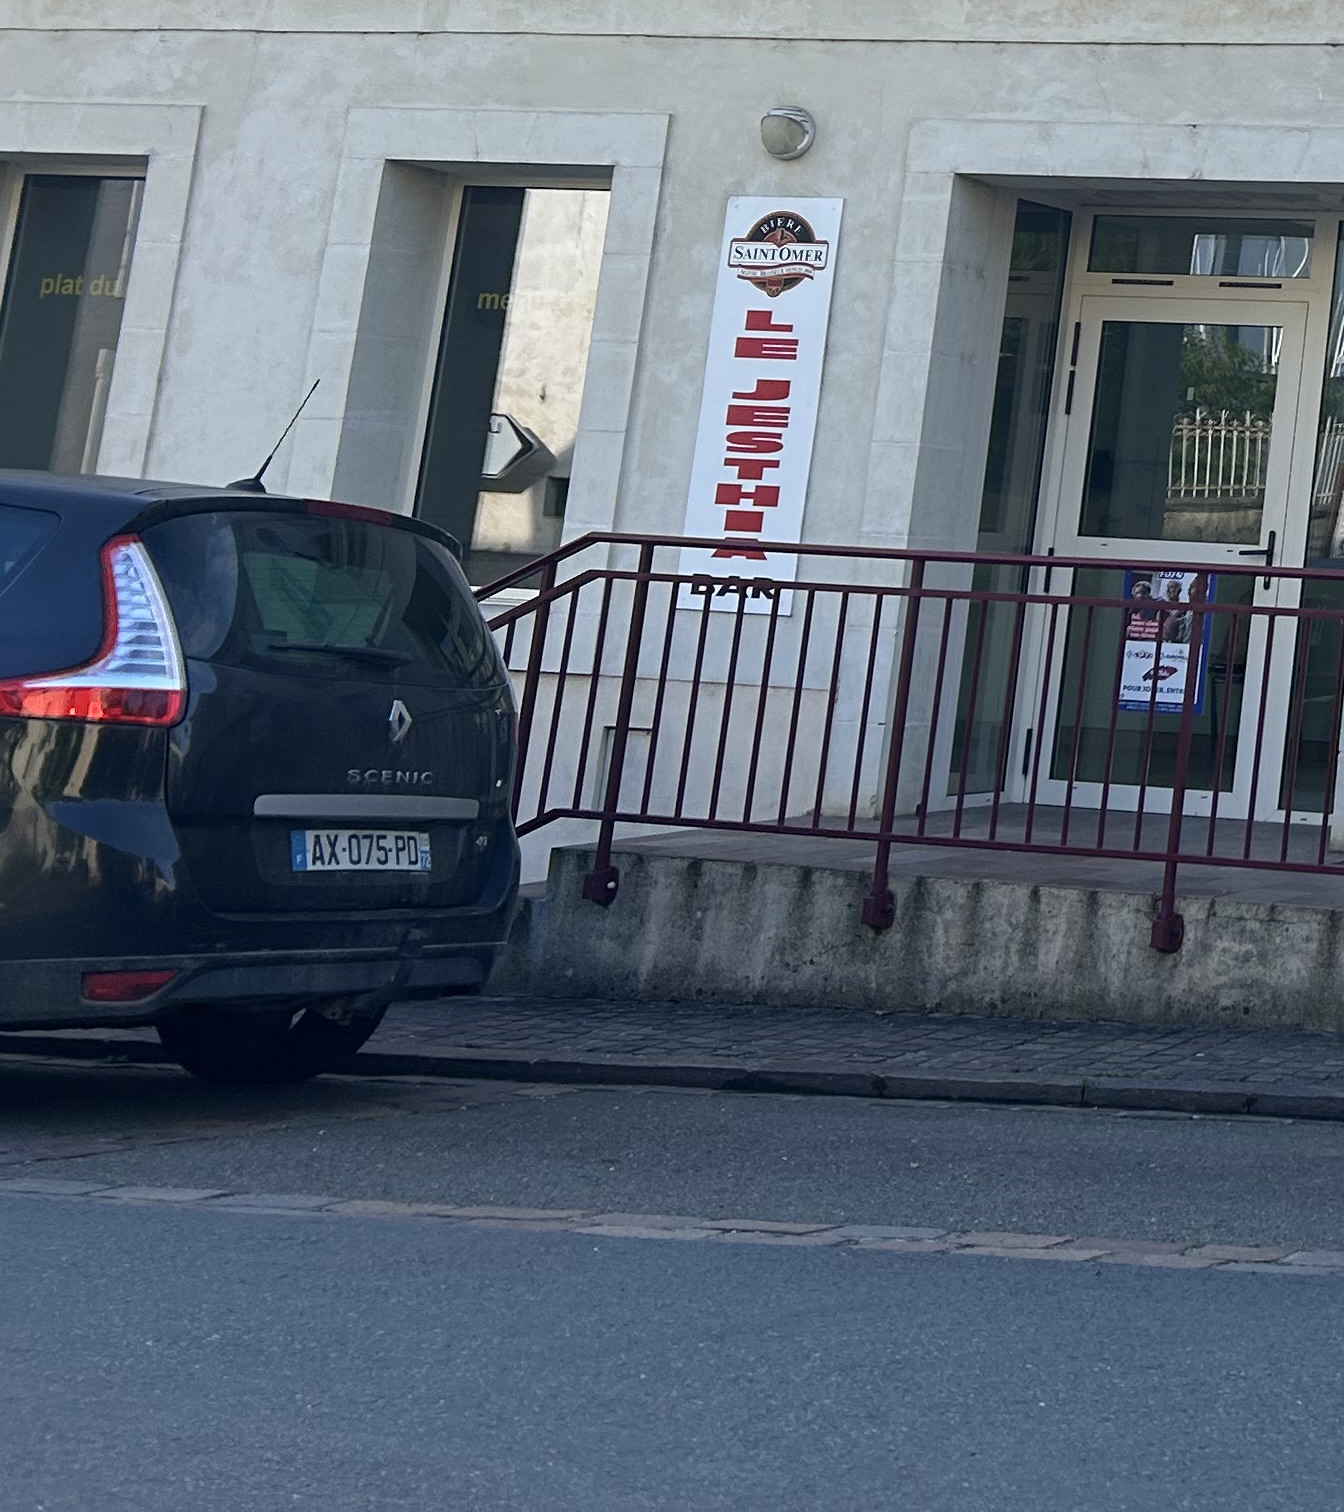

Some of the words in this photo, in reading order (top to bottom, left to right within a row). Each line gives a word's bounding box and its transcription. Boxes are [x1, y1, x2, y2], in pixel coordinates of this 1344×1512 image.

[38, 273, 83, 299] plat
[88, 273, 119, 296] du
[734, 310, 799, 360] LE
[347, 769, 433, 784] SCENIC
